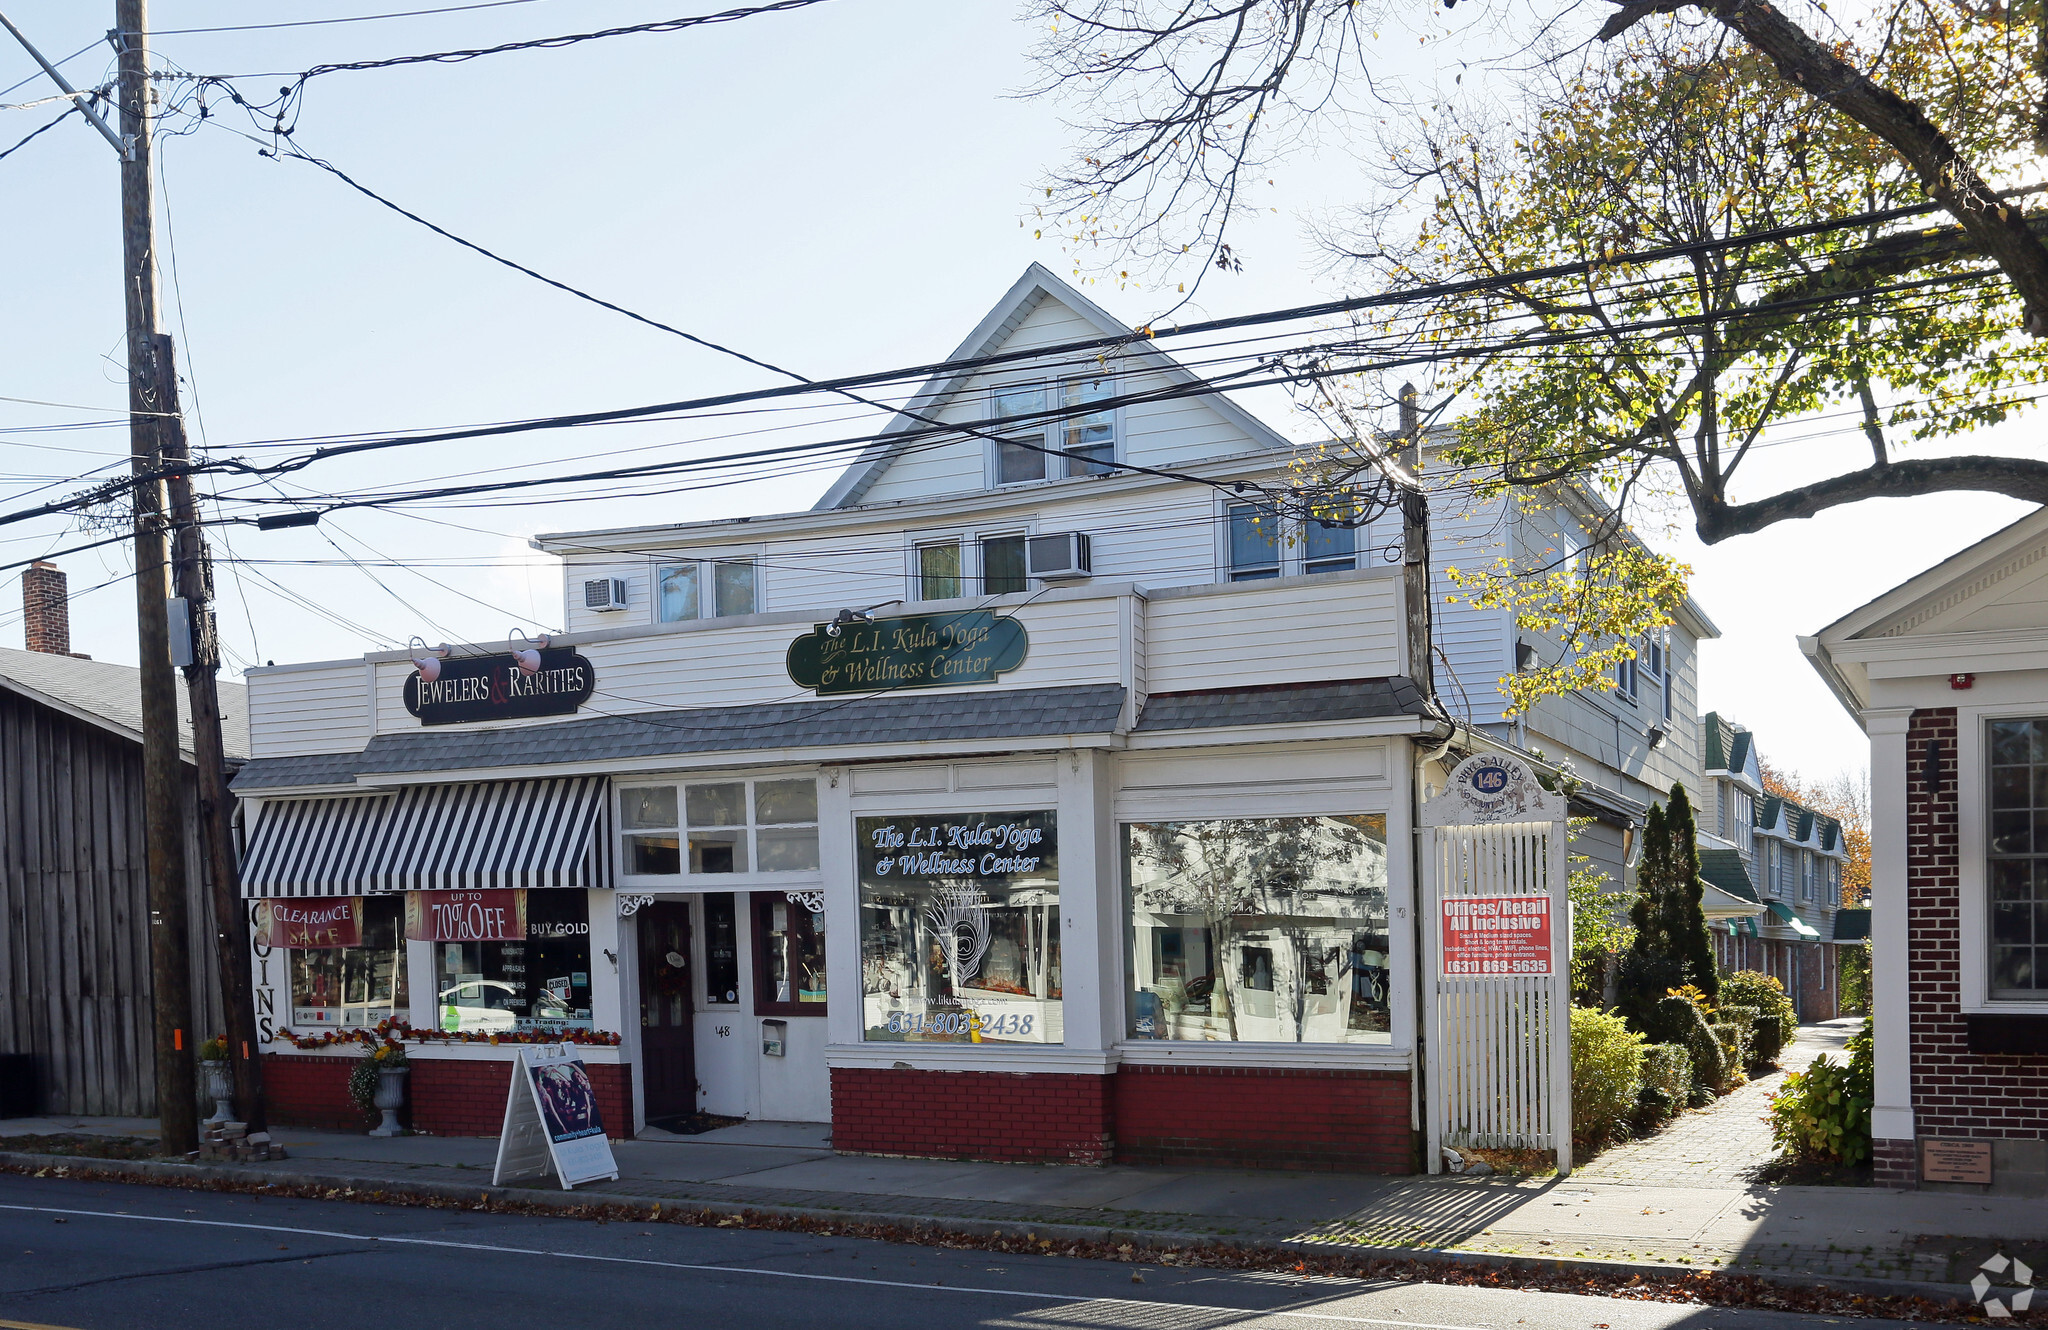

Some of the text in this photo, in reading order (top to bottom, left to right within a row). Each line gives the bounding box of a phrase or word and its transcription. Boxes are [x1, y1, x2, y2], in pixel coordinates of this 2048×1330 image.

[820, 621, 990, 656] The L.I. Kula Yoga
[821, 654, 992, 685] & Wellness Center
[416, 664, 585, 712] JEWELERS & RARITIES
[1458, 756, 1523, 783] PHYL'S ALLEY
[1477, 771, 1503, 789] 146
[872, 822, 1042, 851] The L.I. Kula Yoga
[876, 851, 1040, 876] & Wellness Center
[451, 892, 482, 901] UP TO
[273, 904, 350, 924] CLEARANCE
[1444, 899, 1547, 916] Offices/Retail
[531, 923, 552, 935] BUY
[556, 923, 588, 935] GOLD
[1450, 915, 1541, 931] All Inclusive
[288, 927, 338, 945] SALE
[1447, 960, 1547, 973] (631) 869-5635
[549, 979, 568, 990] CLOSED
[715, 1026, 731, 1038] 148
[888, 1011, 1035, 1035] 631-803-2438
